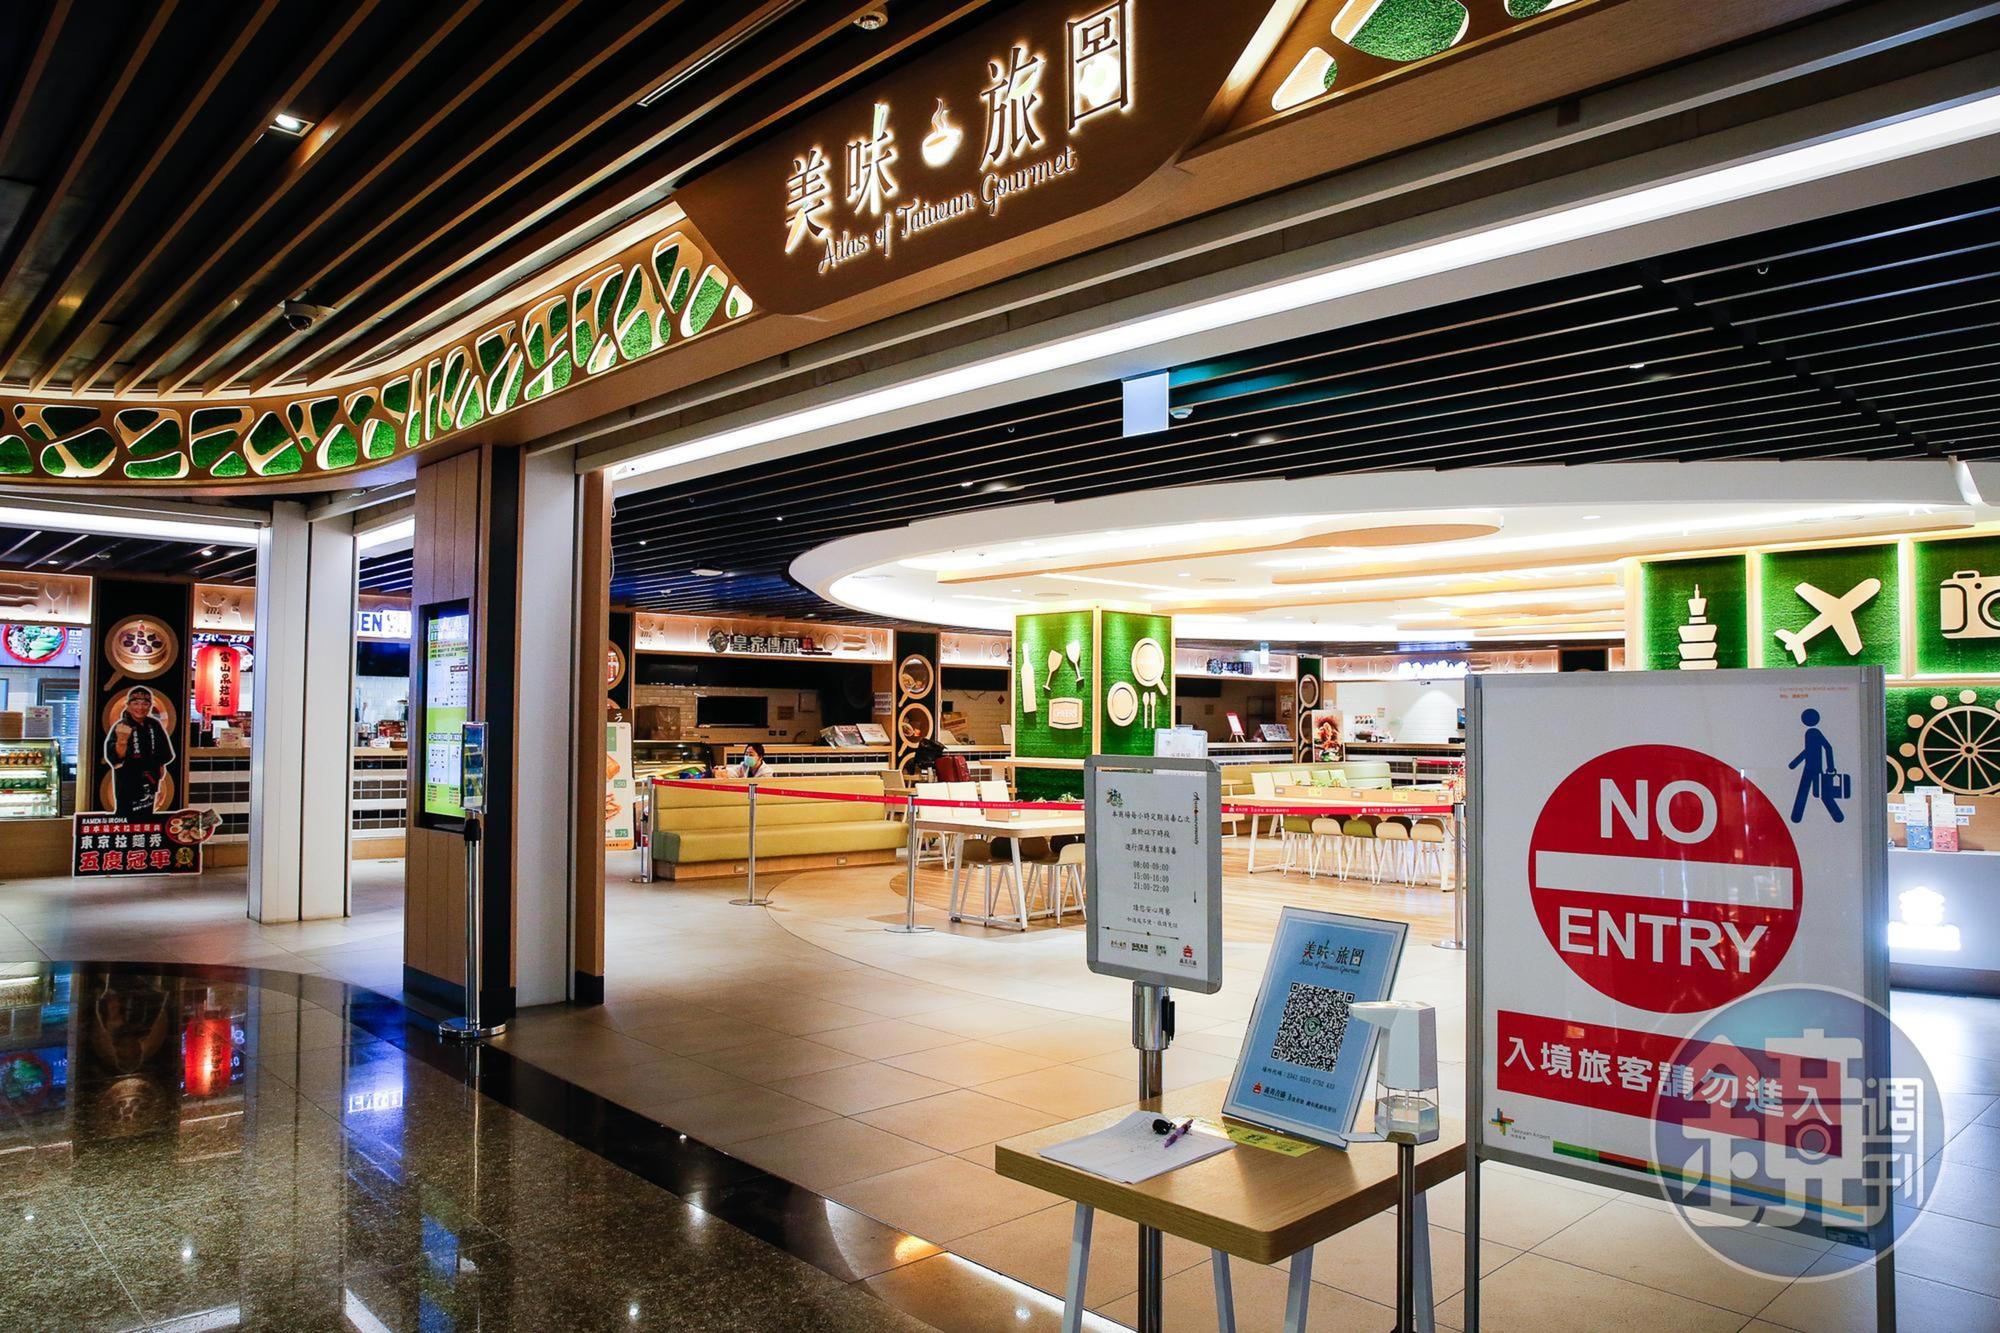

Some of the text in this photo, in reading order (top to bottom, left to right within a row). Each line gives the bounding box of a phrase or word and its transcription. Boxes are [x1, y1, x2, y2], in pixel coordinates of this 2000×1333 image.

[818, 145, 1078, 274] Atlas of Taiwan Gourmet
[357, 613, 382, 632] EN
[733, 634, 799, 654] 皇家傳承
[1600, 778, 1718, 844] NO
[79, 849, 171, 872] 五度冠軍
[80, 834, 162, 849] 東京拉麵秀
[1559, 906, 1769, 974] ENTRY
[1504, 1036, 1832, 1125] 入境旅客請勿進入
